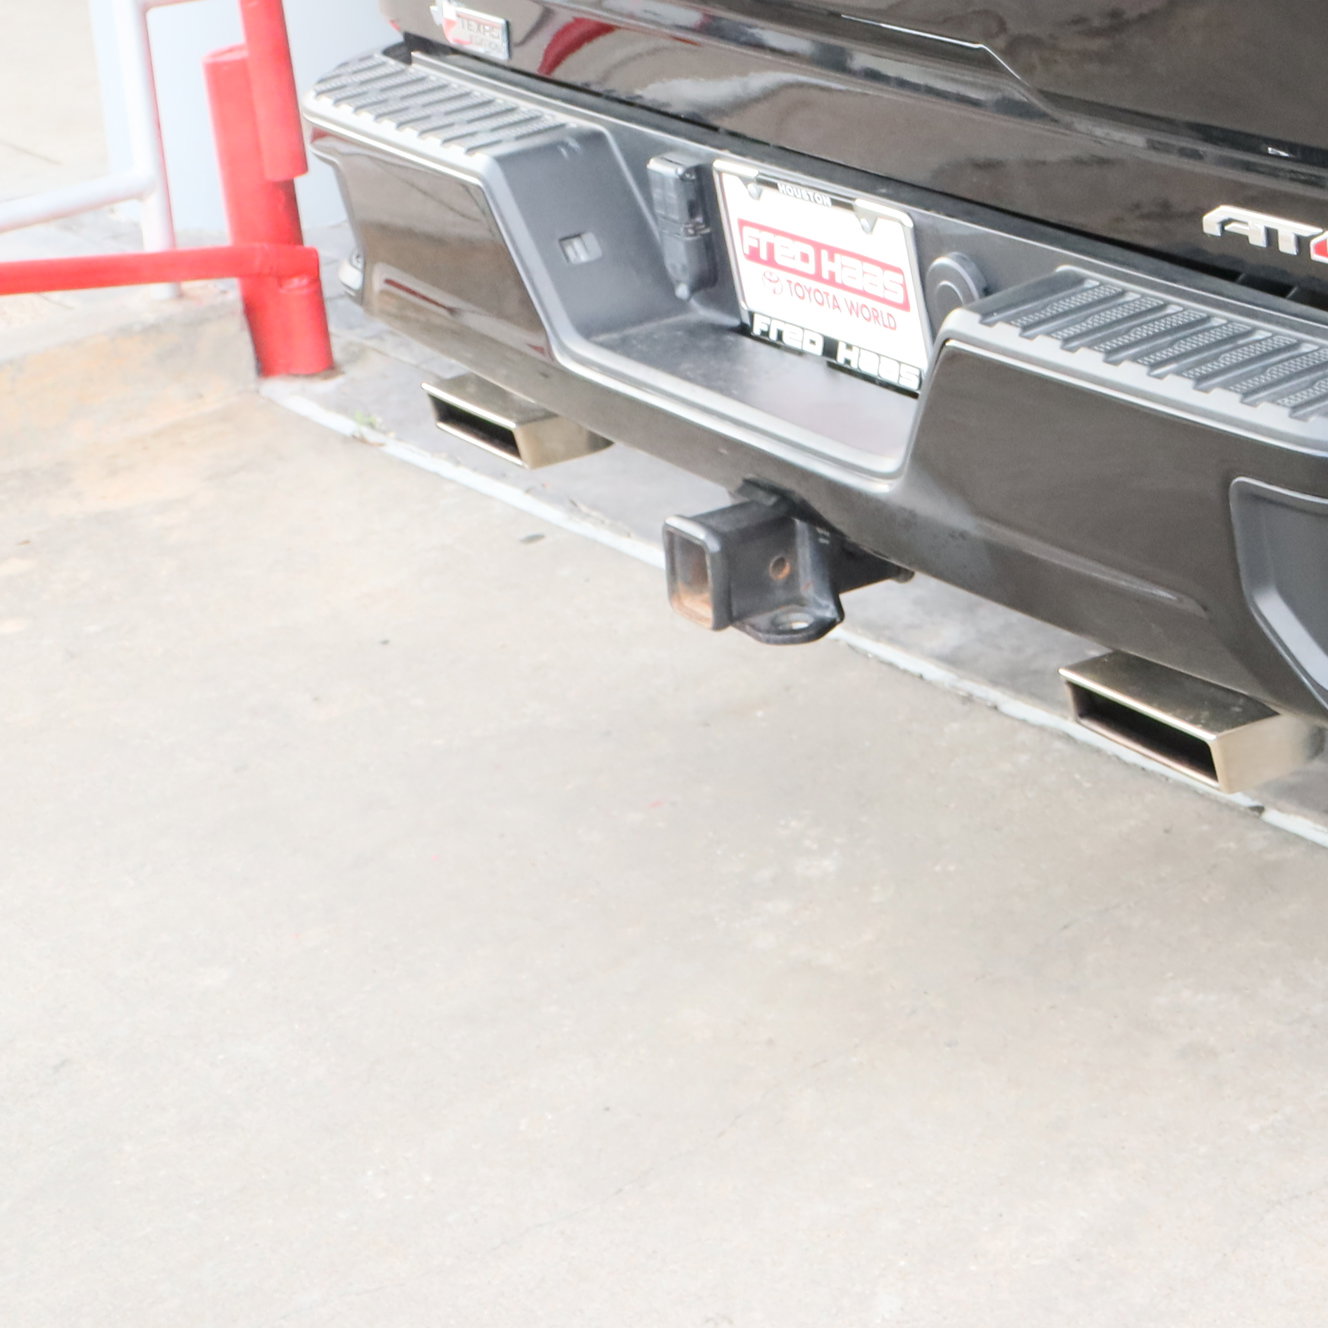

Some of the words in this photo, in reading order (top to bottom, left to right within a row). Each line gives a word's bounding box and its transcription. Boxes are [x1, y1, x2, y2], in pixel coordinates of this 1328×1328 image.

[777, 182, 831, 207] HOUSTON
[786, 279, 842, 312] TOYOTA
[845, 297, 897, 331] WORLD
